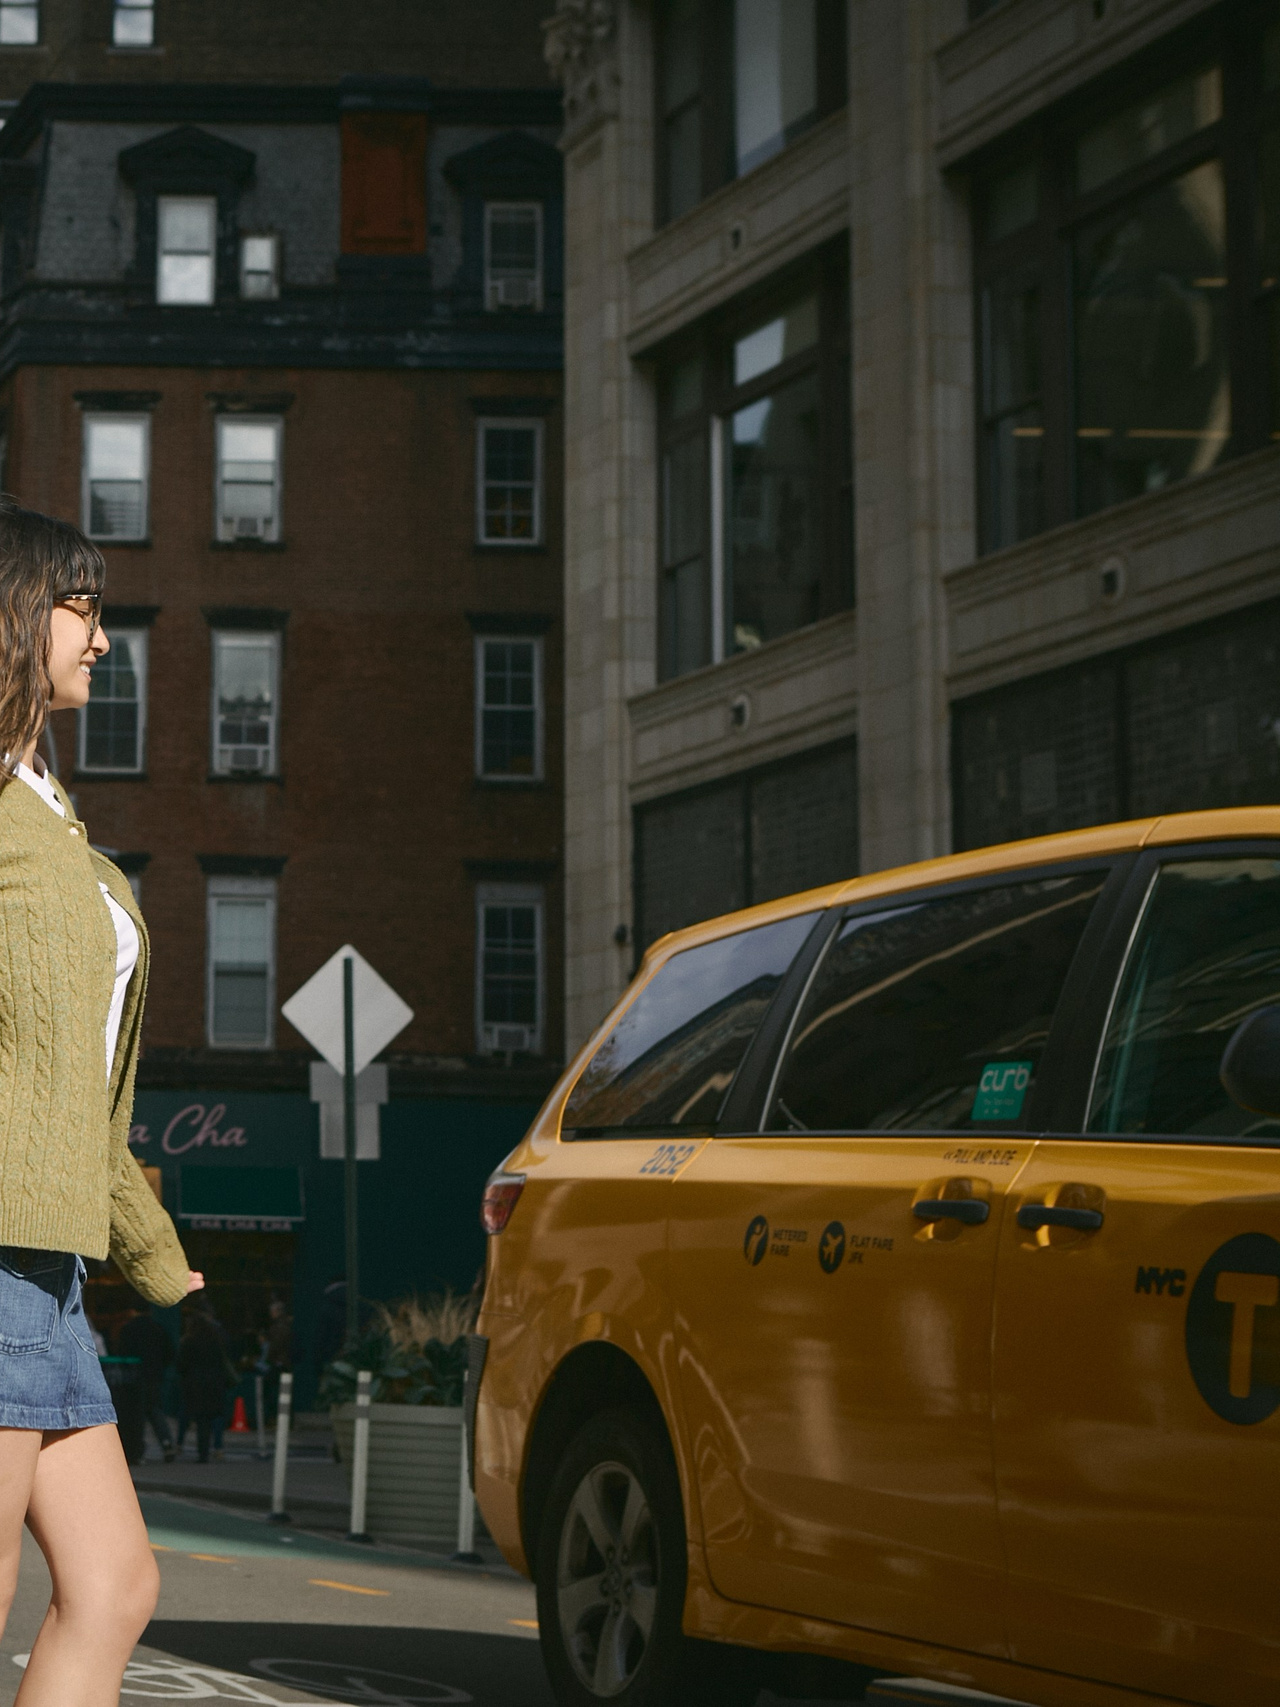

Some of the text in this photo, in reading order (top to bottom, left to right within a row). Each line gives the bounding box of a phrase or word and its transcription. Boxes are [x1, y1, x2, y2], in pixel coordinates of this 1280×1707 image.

[980, 1065, 1030, 1092] curb
[162, 1103, 248, 1155] Cha
[773, 1228, 808, 1243] METERED
[850, 1234, 895, 1252] FLAT FARE
[770, 1243, 790, 1257] FARE
[848, 1251, 865, 1264] JFK
[1135, 1265, 1188, 1297] NYC
[1214, 1270, 1279, 1399] T
